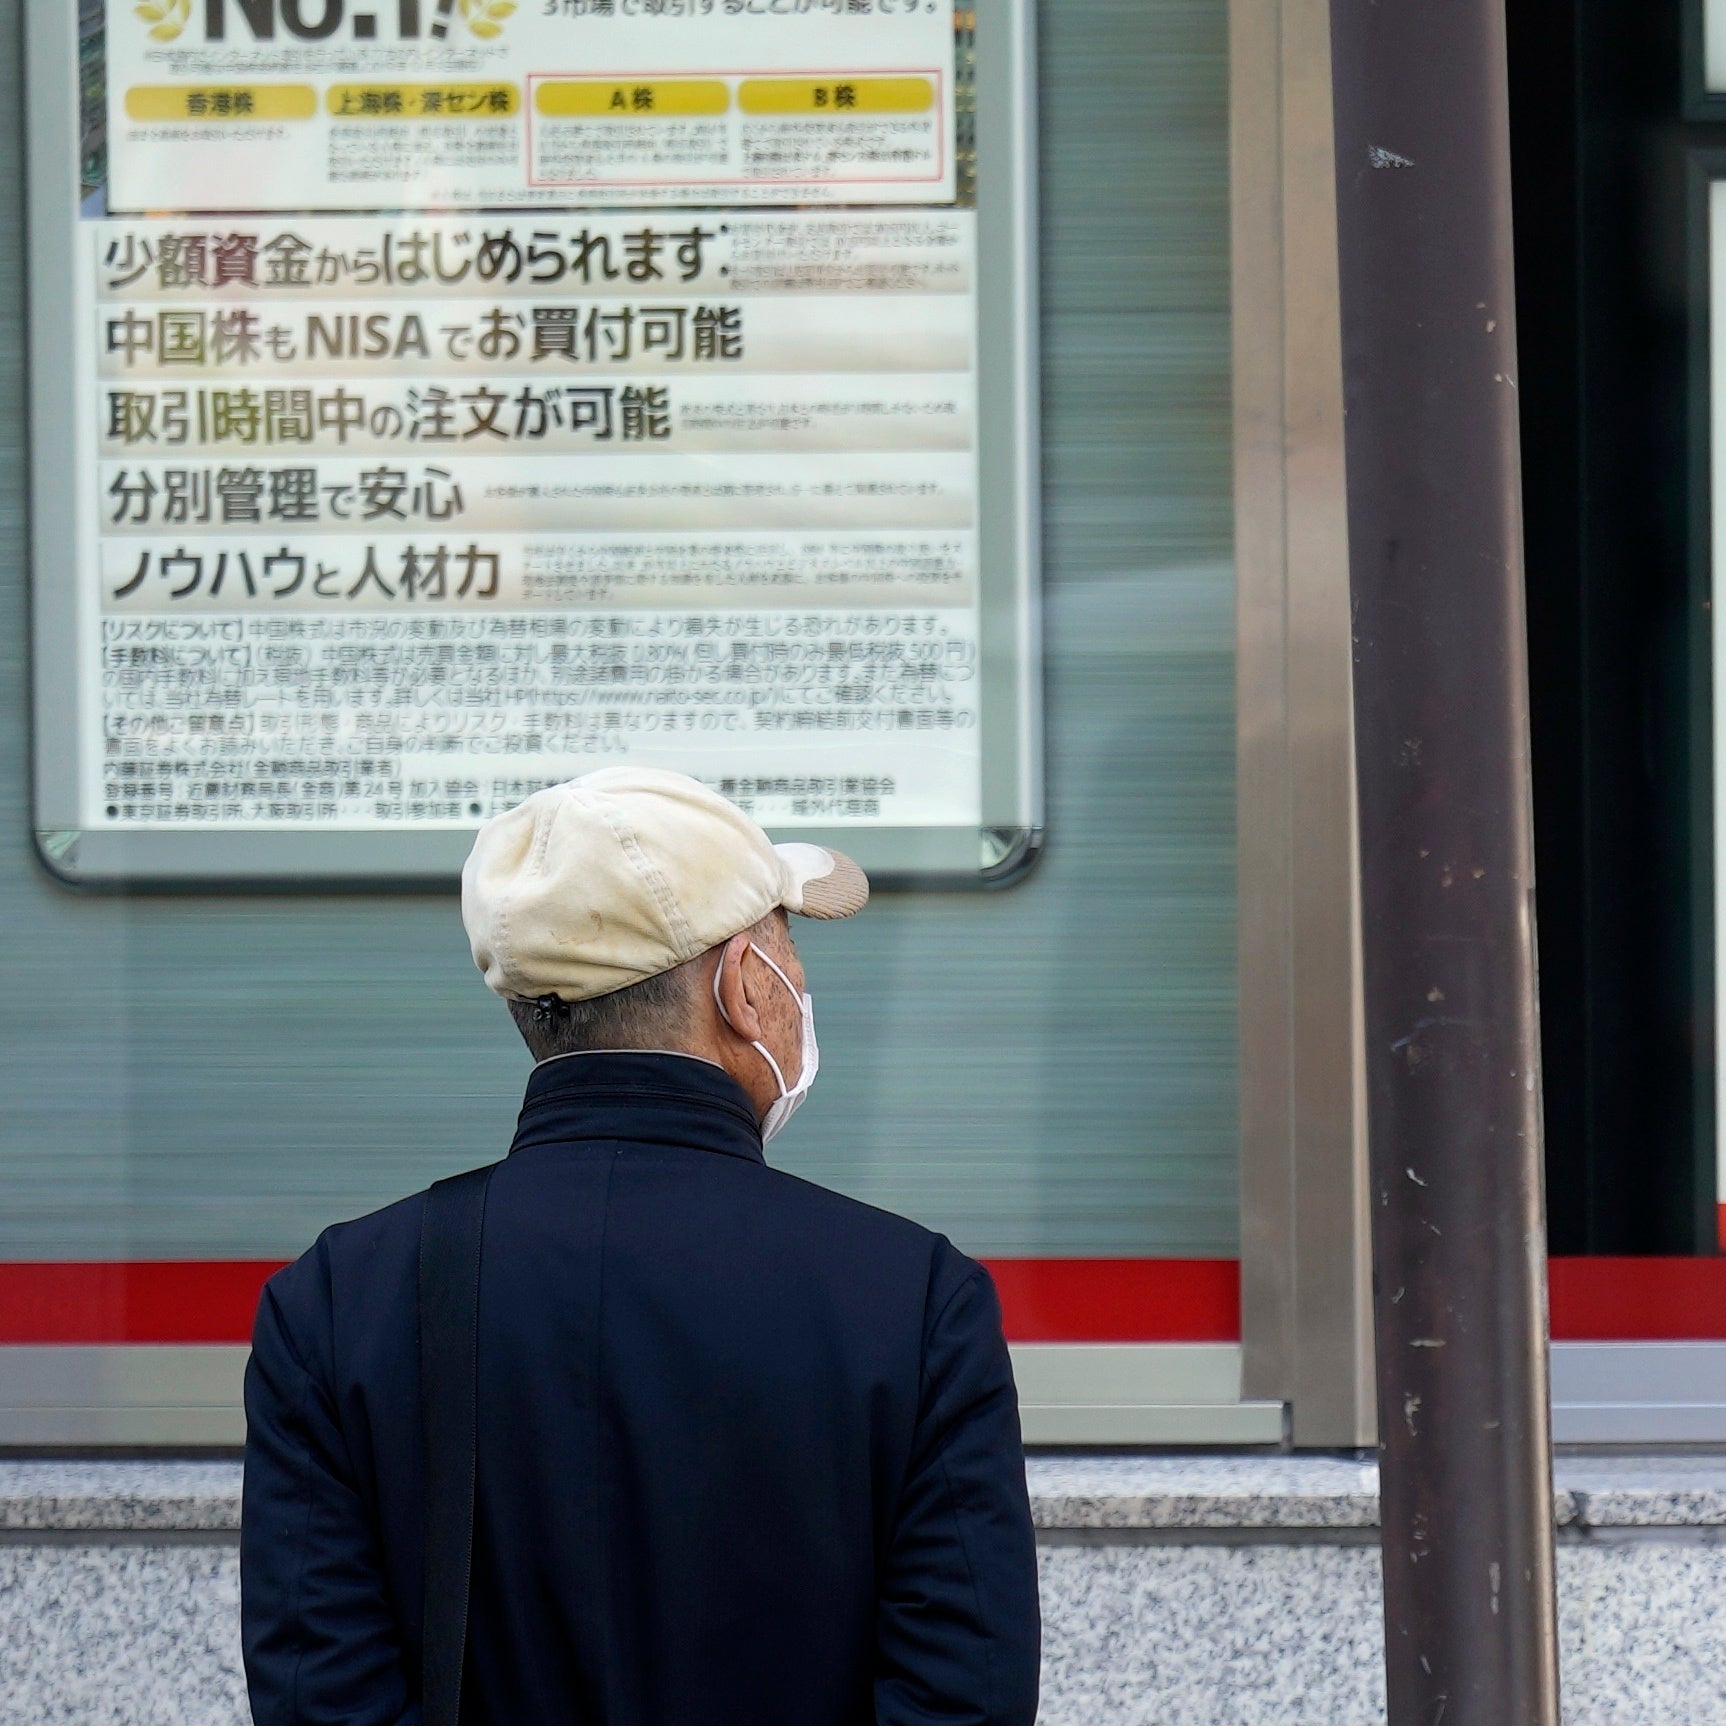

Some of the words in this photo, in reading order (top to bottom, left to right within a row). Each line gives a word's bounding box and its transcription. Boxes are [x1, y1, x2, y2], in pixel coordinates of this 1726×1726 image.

[107, 384, 672, 443] 取引時間中の注文が可能
[109, 465, 465, 526] 分別管理で安心
[112, 542, 502, 602] ノウハウと人材力
